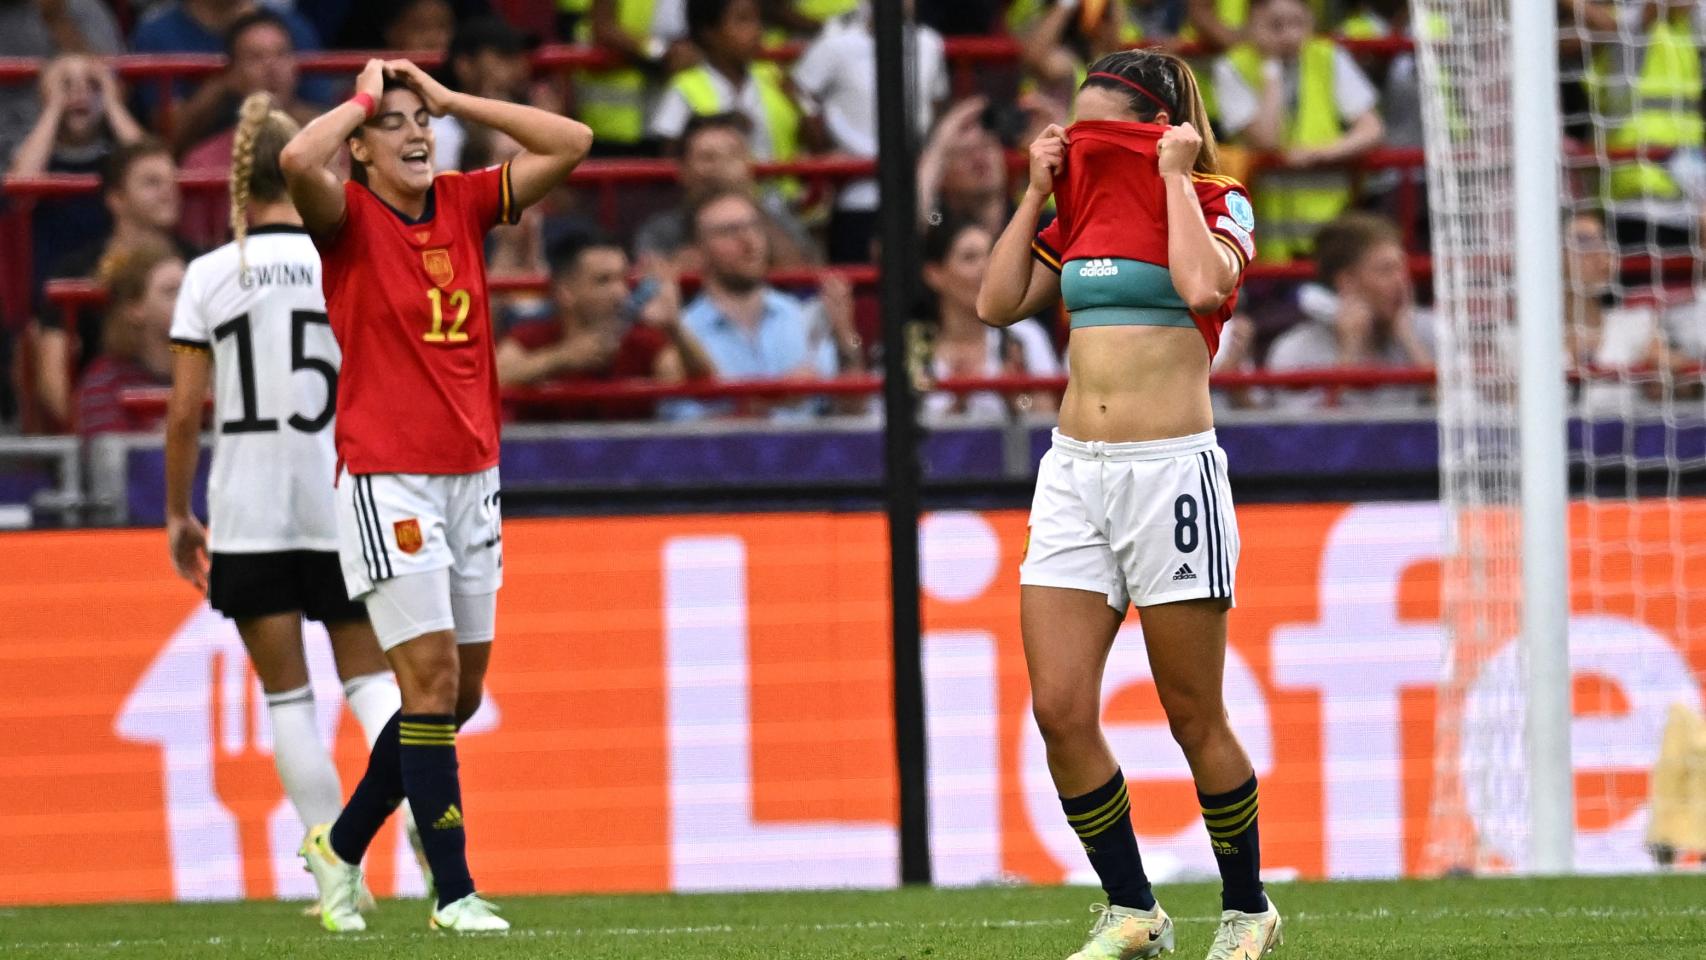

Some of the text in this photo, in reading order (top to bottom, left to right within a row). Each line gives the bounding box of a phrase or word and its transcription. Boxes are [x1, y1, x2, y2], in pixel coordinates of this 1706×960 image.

[239, 264, 314, 291] GWINN
[1080, 266, 1118, 277] adidas
[423, 288, 471, 342] 12
[214, 309, 339, 434] 15
[1174, 493, 1198, 554] 8
[664, 502, 1706, 893] Liefe
